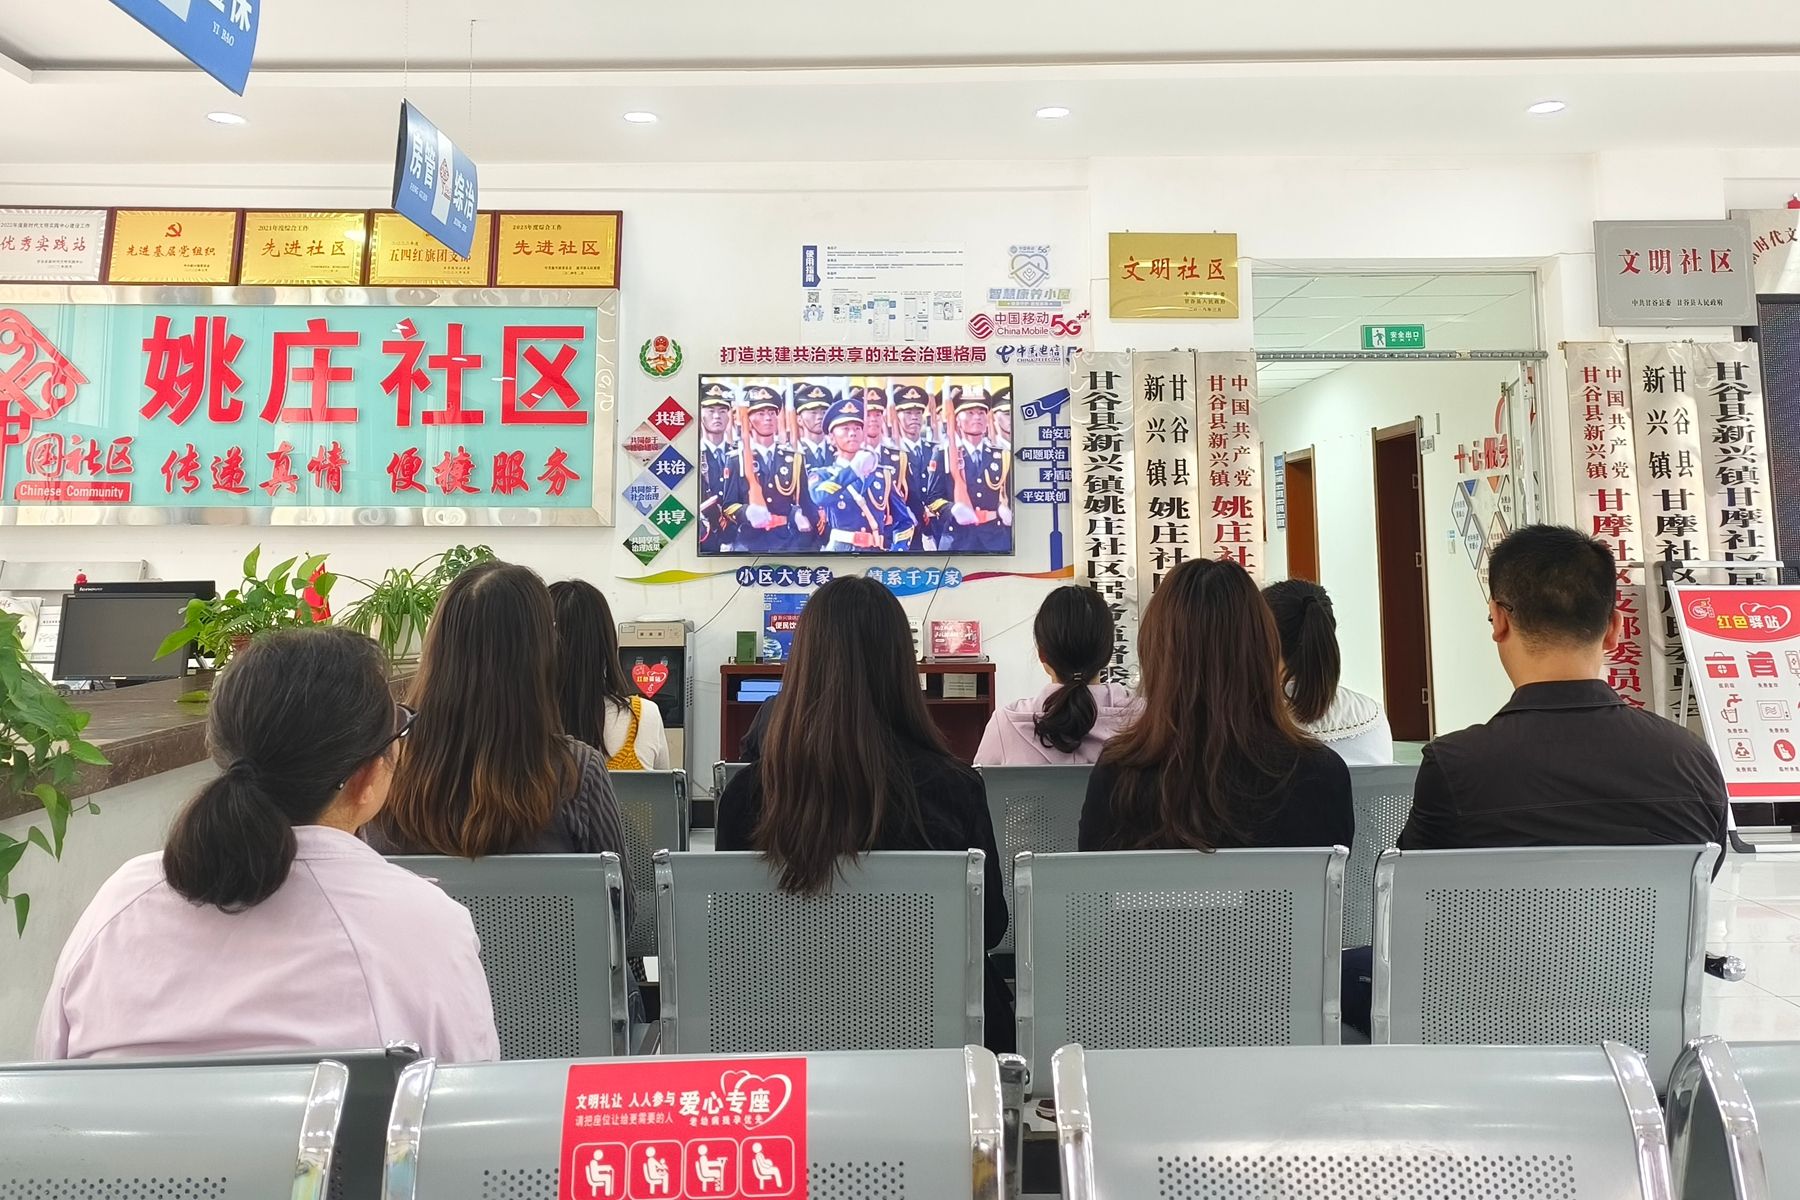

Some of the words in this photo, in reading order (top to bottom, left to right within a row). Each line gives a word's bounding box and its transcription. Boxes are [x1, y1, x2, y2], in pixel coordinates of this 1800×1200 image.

[212, 21, 220, 35] YI
[409, 131, 436, 190] 房管
[452, 169, 474, 221] 综治
[0, 235, 86, 252] 优秀实践站
[126, 244, 216, 258] 先进基层党组织
[261, 238, 346, 257] 先进社区
[512, 240, 600, 256] 先进社区
[1121, 255, 1227, 282] 文明社区
[1617, 248, 1734, 275] 文明社区
[995, 311, 1049, 325] 中国移动
[997, 327, 1020, 336] China
[1021, 327, 1049, 336] Mobile
[1389, 330, 1420, 339] 安全出口
[720, 346, 987, 364] 打造共建共治共享的社会治理格局
[138, 314, 588, 428] 姚庄社区
[655, 410, 686, 427] 共建
[1580, 366, 1607, 479] 甘谷县新兴镇
[1605, 366, 1629, 479] 中国共产党
[1643, 365, 1672, 479] 新兴镇
[1669, 365, 1694, 478] 甘谷县
[1144, 373, 1168, 487] 新兴镇
[1169, 374, 1190, 486] 甘谷县
[1207, 374, 1230, 487] 甘谷县新兴镇
[1231, 374, 1252, 487] 中国共产党
[1022, 449, 1065, 460] 问题联治
[160, 440, 349, 496] 传递真情
[385, 445, 582, 497] 便捷服务
[656, 459, 686, 476] 共治
[20, 484, 62, 496] Chinese
[66, 485, 124, 498] Community
[1023, 491, 1066, 502] 平安联创
[656, 509, 687, 525] 共享
[1211, 496, 1256, 575] 姚庄社
[1148, 497, 1190, 594] 姚庄社
[739, 568, 832, 586] 小区大管家
[868, 569, 960, 586] 情系千万家
[1717, 615, 1780, 629] 红色驿站
[575, 1093, 623, 1110] 文明礼让
[628, 1091, 676, 1108] 人人参与
[678, 1087, 771, 1116] 爱心专座
[575, 1112, 673, 1127] 请把座位让给更需要的人
